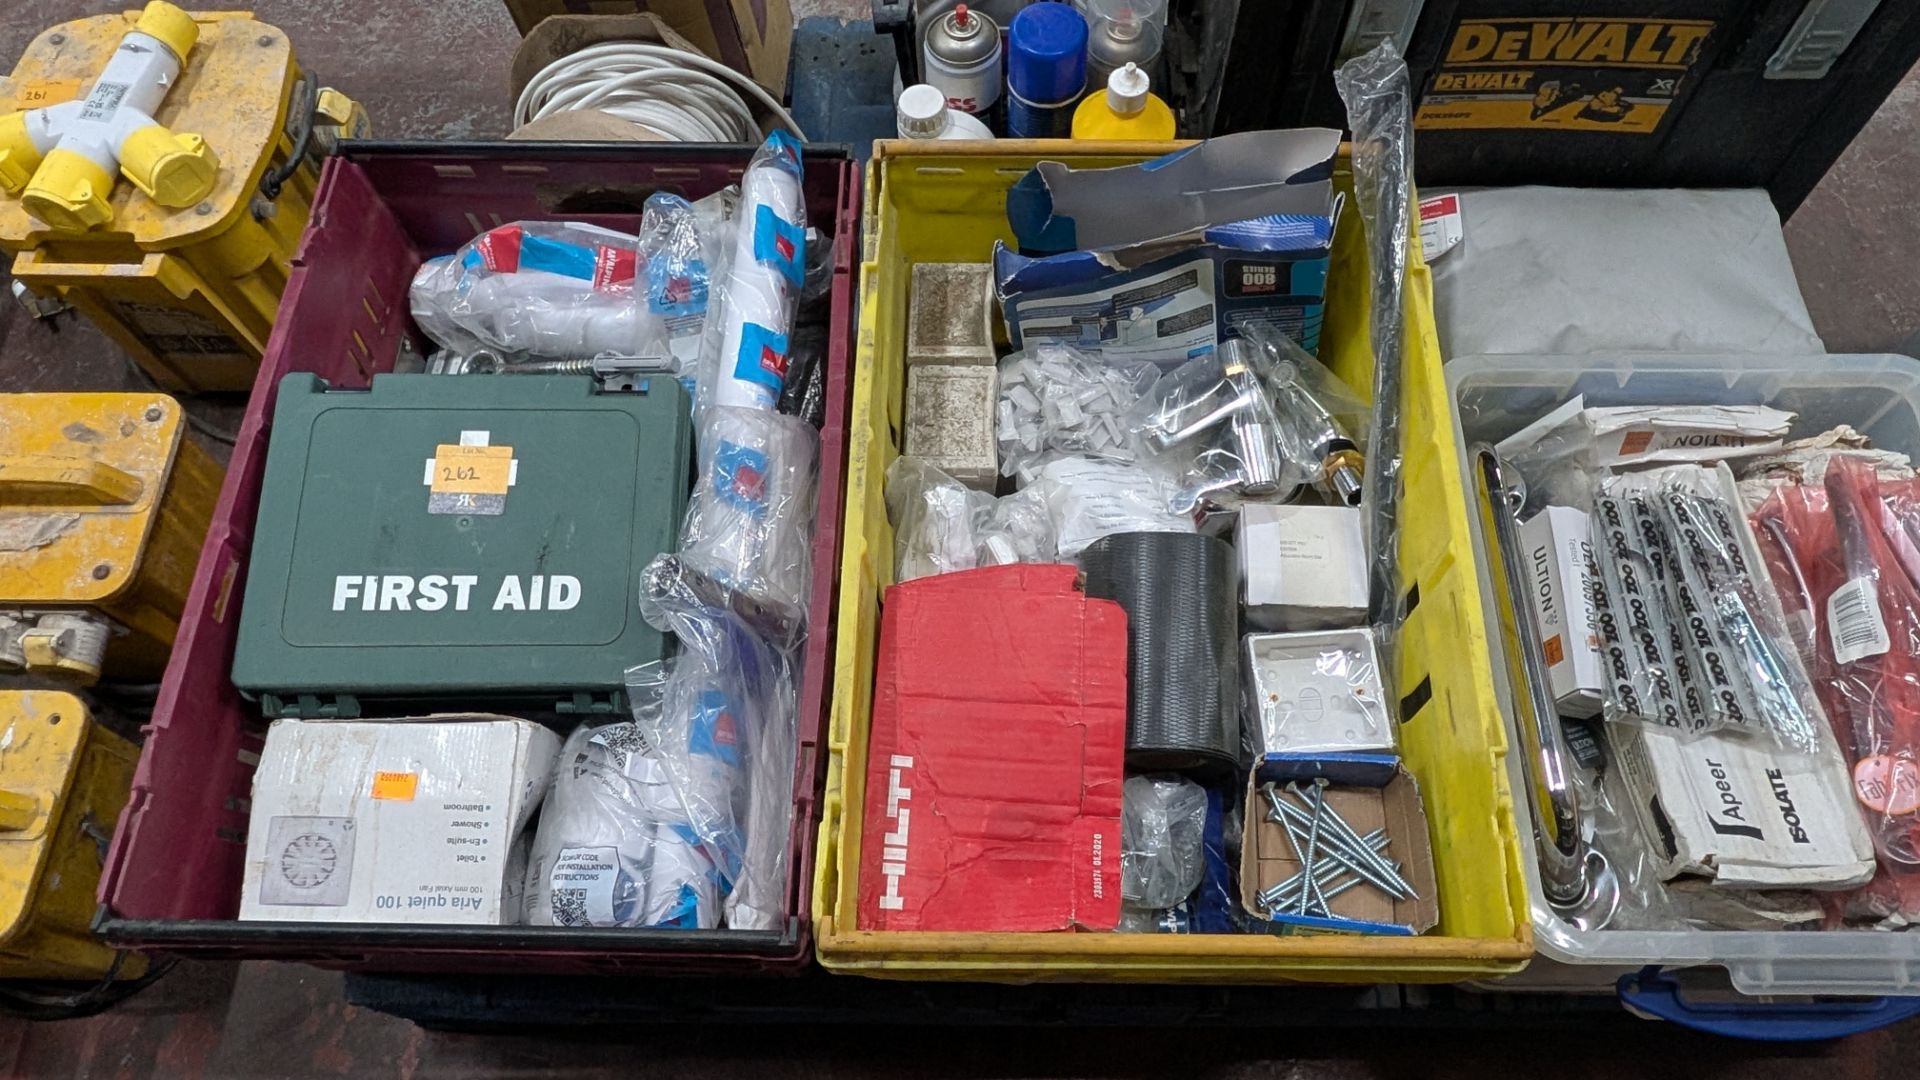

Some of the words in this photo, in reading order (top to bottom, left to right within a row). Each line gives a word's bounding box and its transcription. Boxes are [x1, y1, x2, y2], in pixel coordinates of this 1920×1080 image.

[25, 91, 47, 100] 261
[1242, 273, 1276, 285] 800
[443, 466, 480, 481] 262
[1603, 500, 1621, 527] ZOO
[1613, 531, 1629, 560] ZOO
[1641, 519, 1660, 547] ZOO
[332, 575, 477, 611] FIRST
[492, 575, 582, 611] AID
[1533, 545, 1552, 612] ULTION
[1622, 564, 1639, 595] ZOO
[1600, 613, 1619, 642] ZOO
[1631, 599, 1649, 629] ZOO
[1691, 617, 1713, 648] ZOO
[1641, 632, 1662, 664] ZOO
[1610, 647, 1628, 681] ZOO
[1705, 652, 1729, 685] ZOO
[1618, 684, 1640, 716] ZOO
[1706, 758, 1745, 821] Apeer
[443, 804, 483, 812] Bathroom
[1765, 768, 1810, 843] ISOLATE
[451, 821, 482, 829] Shower
[879, 755, 913, 910] HILTI
[376, 895, 402, 909] 100
[408, 894, 446, 909] quiet
[451, 896, 483, 910] Aria
